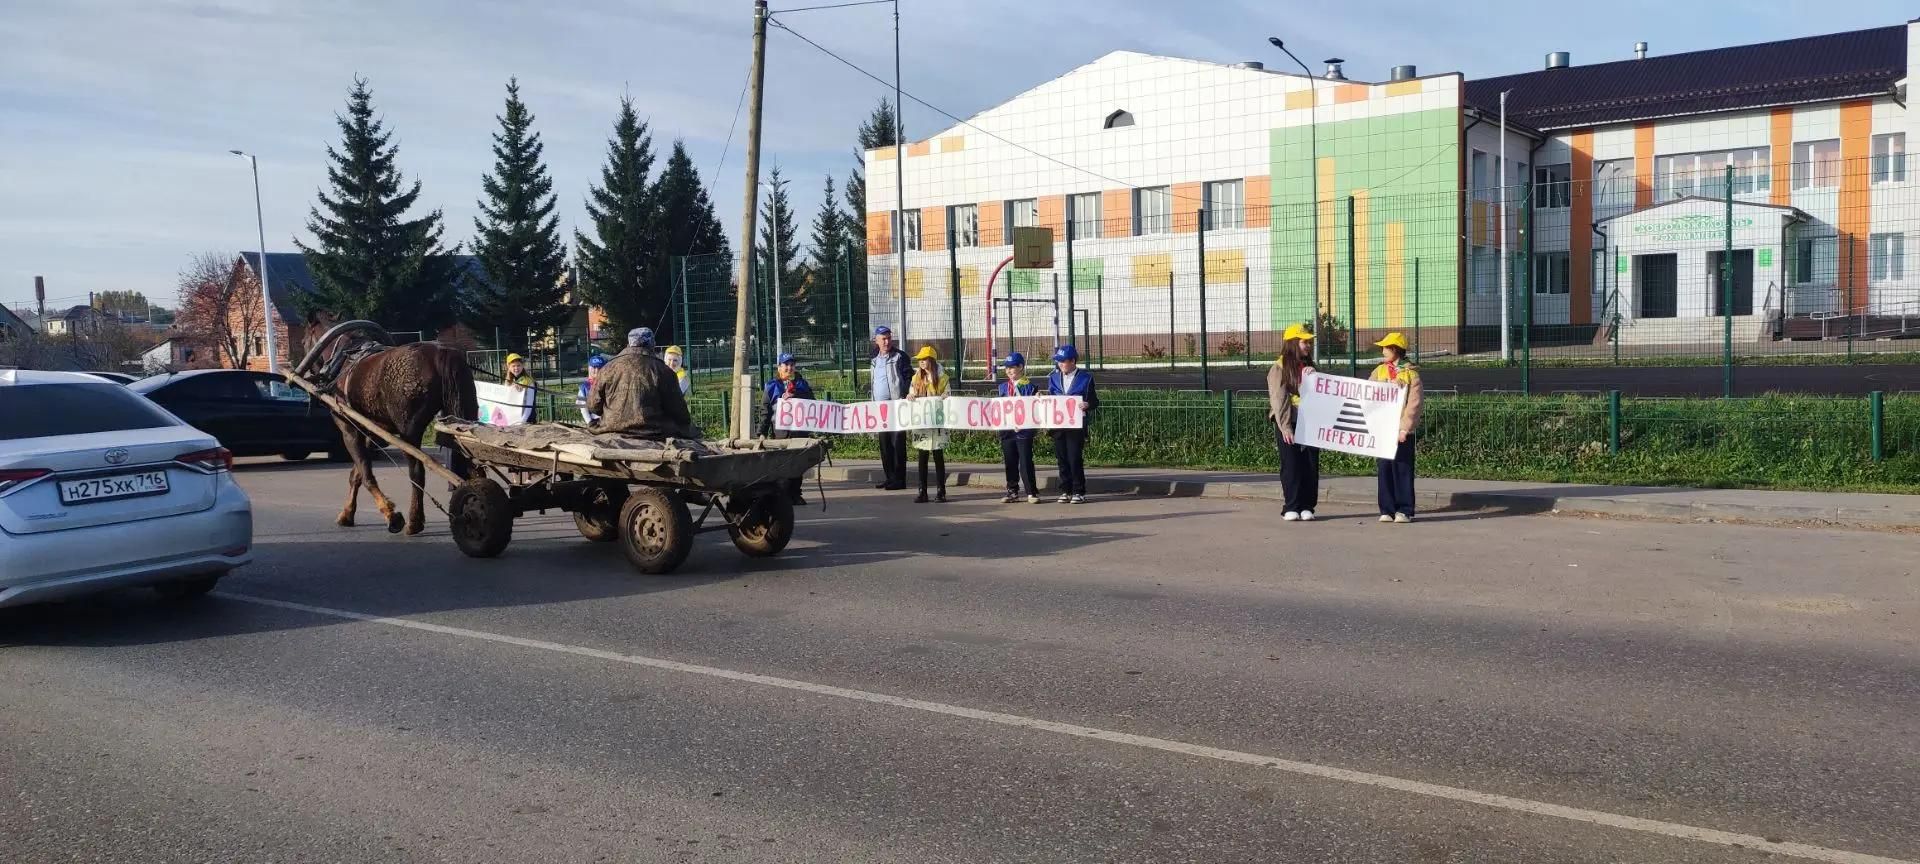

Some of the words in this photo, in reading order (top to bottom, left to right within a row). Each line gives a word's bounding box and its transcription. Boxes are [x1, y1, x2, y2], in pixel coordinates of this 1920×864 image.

[1315, 377, 1399, 403] БЕЗОПАСНЫЙ
[780, 401, 888, 431] ВОДИТЕЛЬ!
[897, 400, 959, 428] СБАВЬ
[1317, 427, 1376, 449] ПЕРЕХОД
